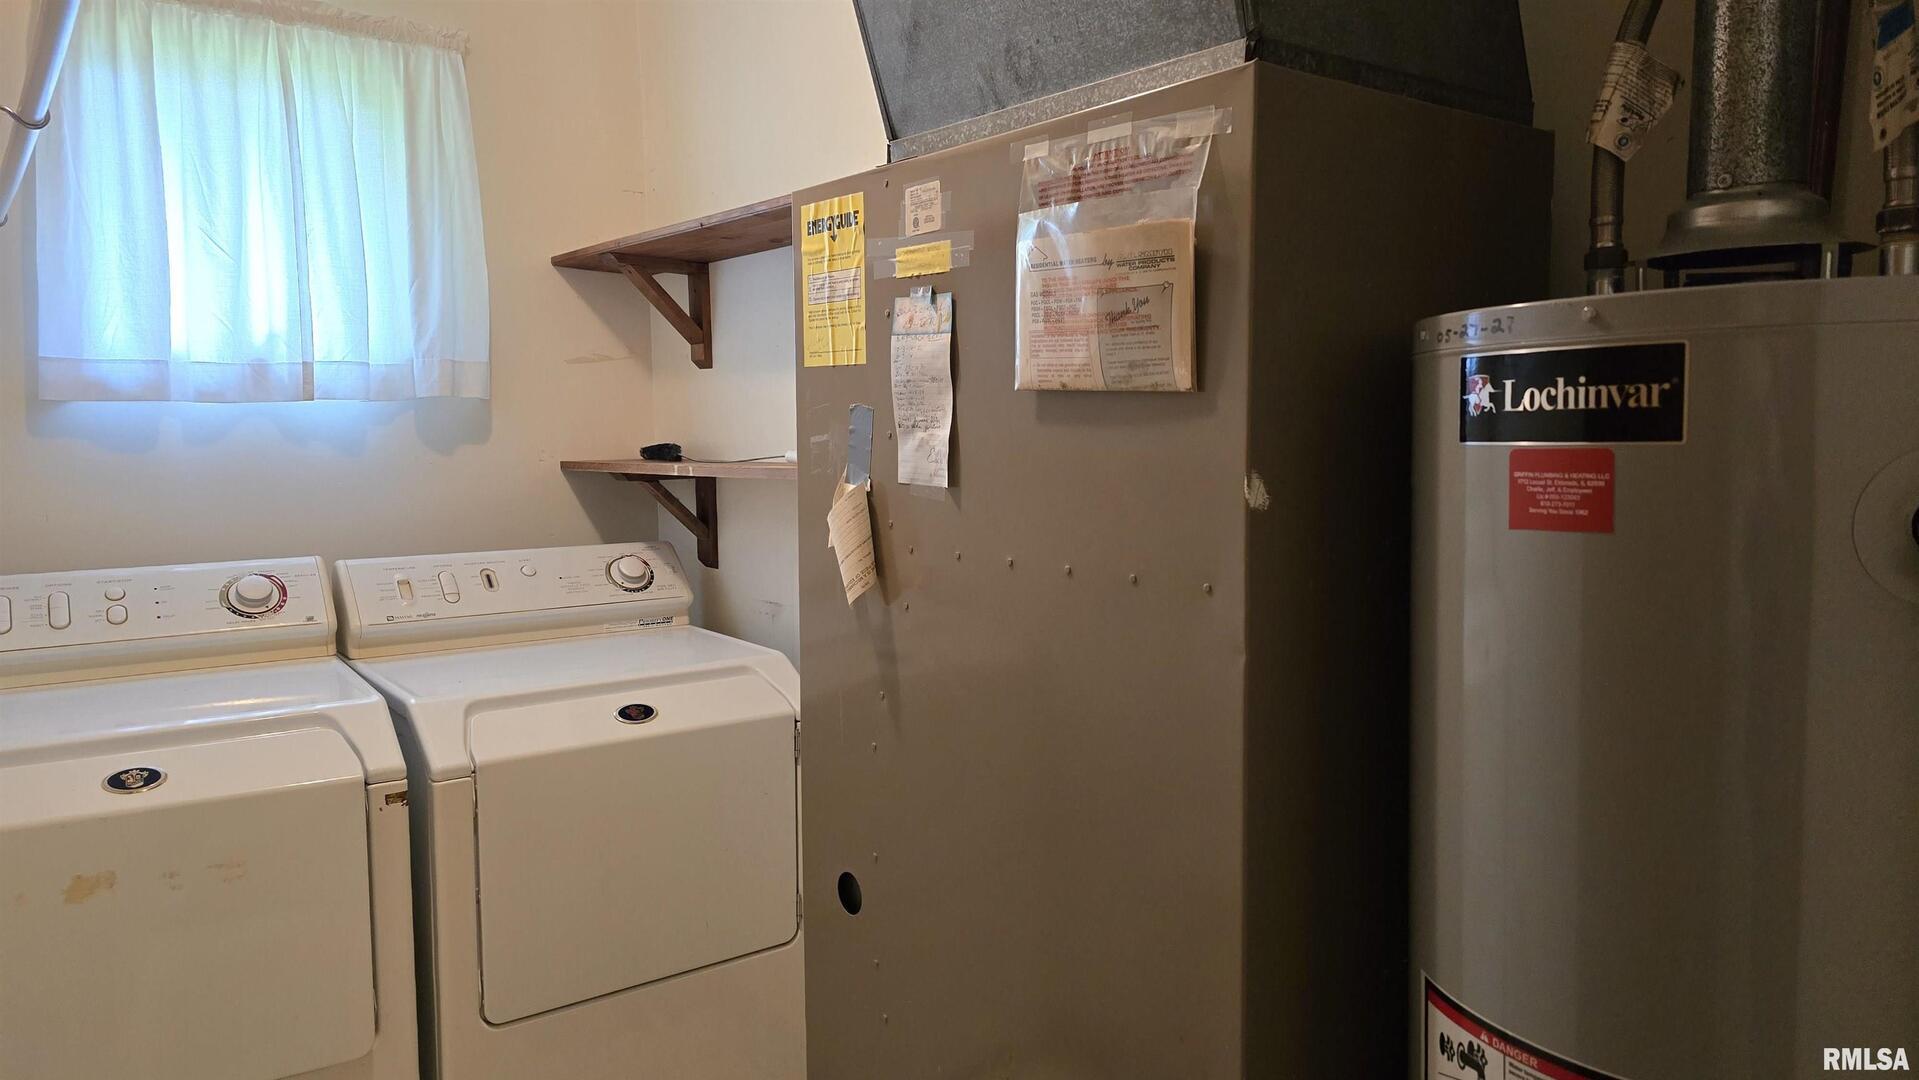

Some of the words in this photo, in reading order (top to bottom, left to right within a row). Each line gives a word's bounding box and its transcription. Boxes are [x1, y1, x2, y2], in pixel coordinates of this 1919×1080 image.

[807, 209, 859, 236] ENERGYGUIDE
[1128, 263, 1161, 271] COMPANY
[1105, 301, 1132, 324] Thank
[1132, 296, 1150, 314] You
[1502, 375, 1671, 412] Lochinvar
[1570, 472, 1597, 480] HEATING
[1492, 1037, 1538, 1070] DANGER
